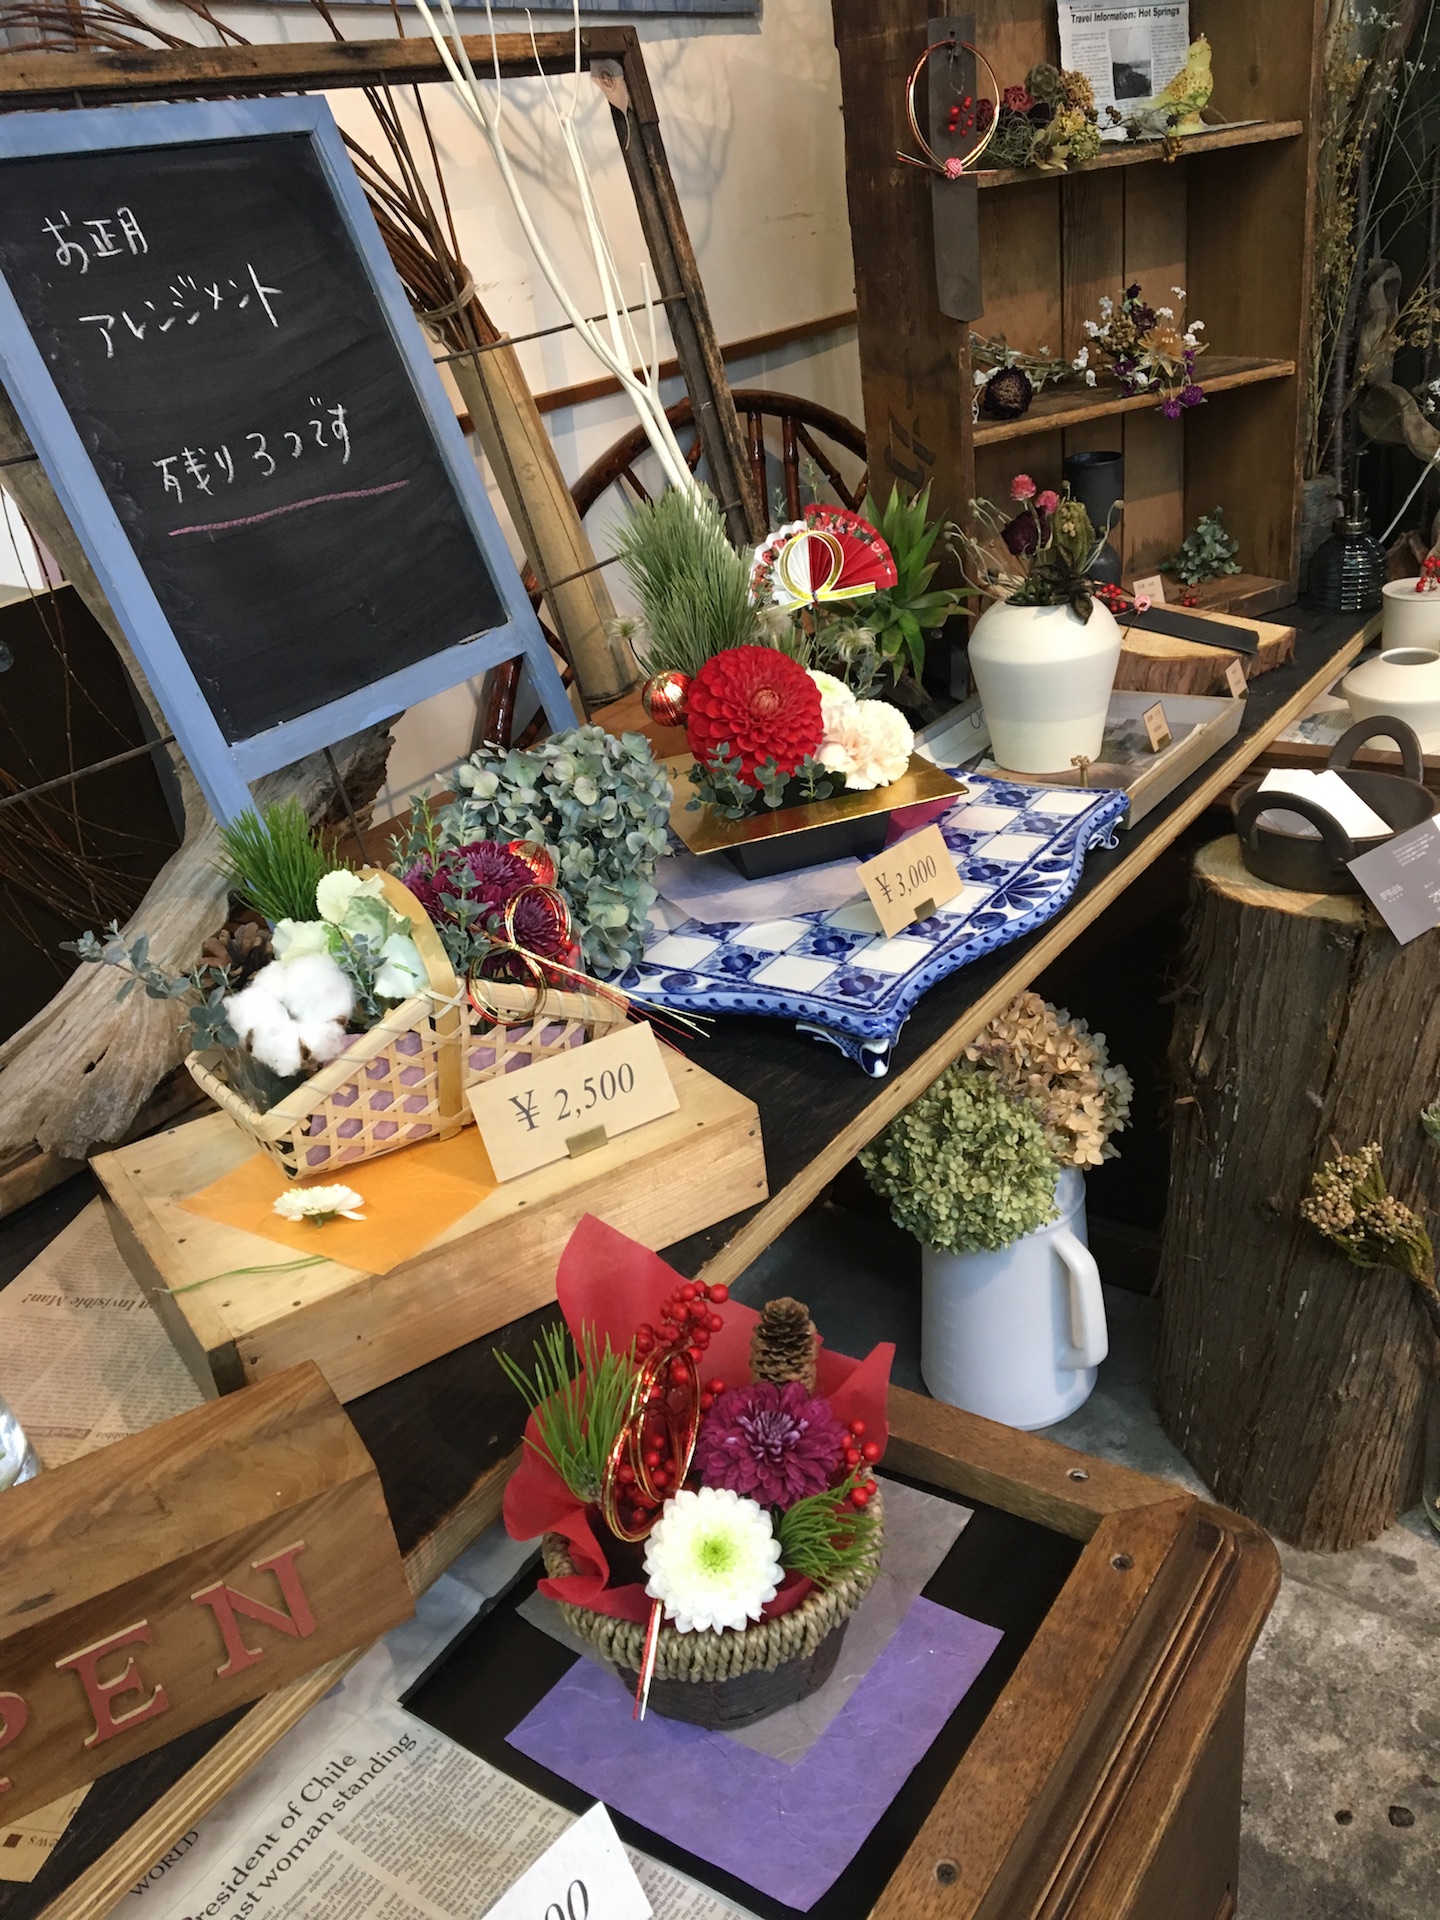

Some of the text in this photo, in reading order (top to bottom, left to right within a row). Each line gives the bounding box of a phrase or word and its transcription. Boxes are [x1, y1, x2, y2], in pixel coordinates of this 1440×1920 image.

[1071, 7, 1180, 23] Travel Information: Hot Springs
[42, 207, 149, 274] お正月
[79, 263, 283, 358] アレンジメント
[22, 1293, 65, 1308] Man!
[70, 1296, 136, 1312] Invisible
[181, 1753, 357, 1920] resident of Chile
[228, 1732, 417, 1920] ast woman standing
[129, 1830, 199, 1896] WORLD
